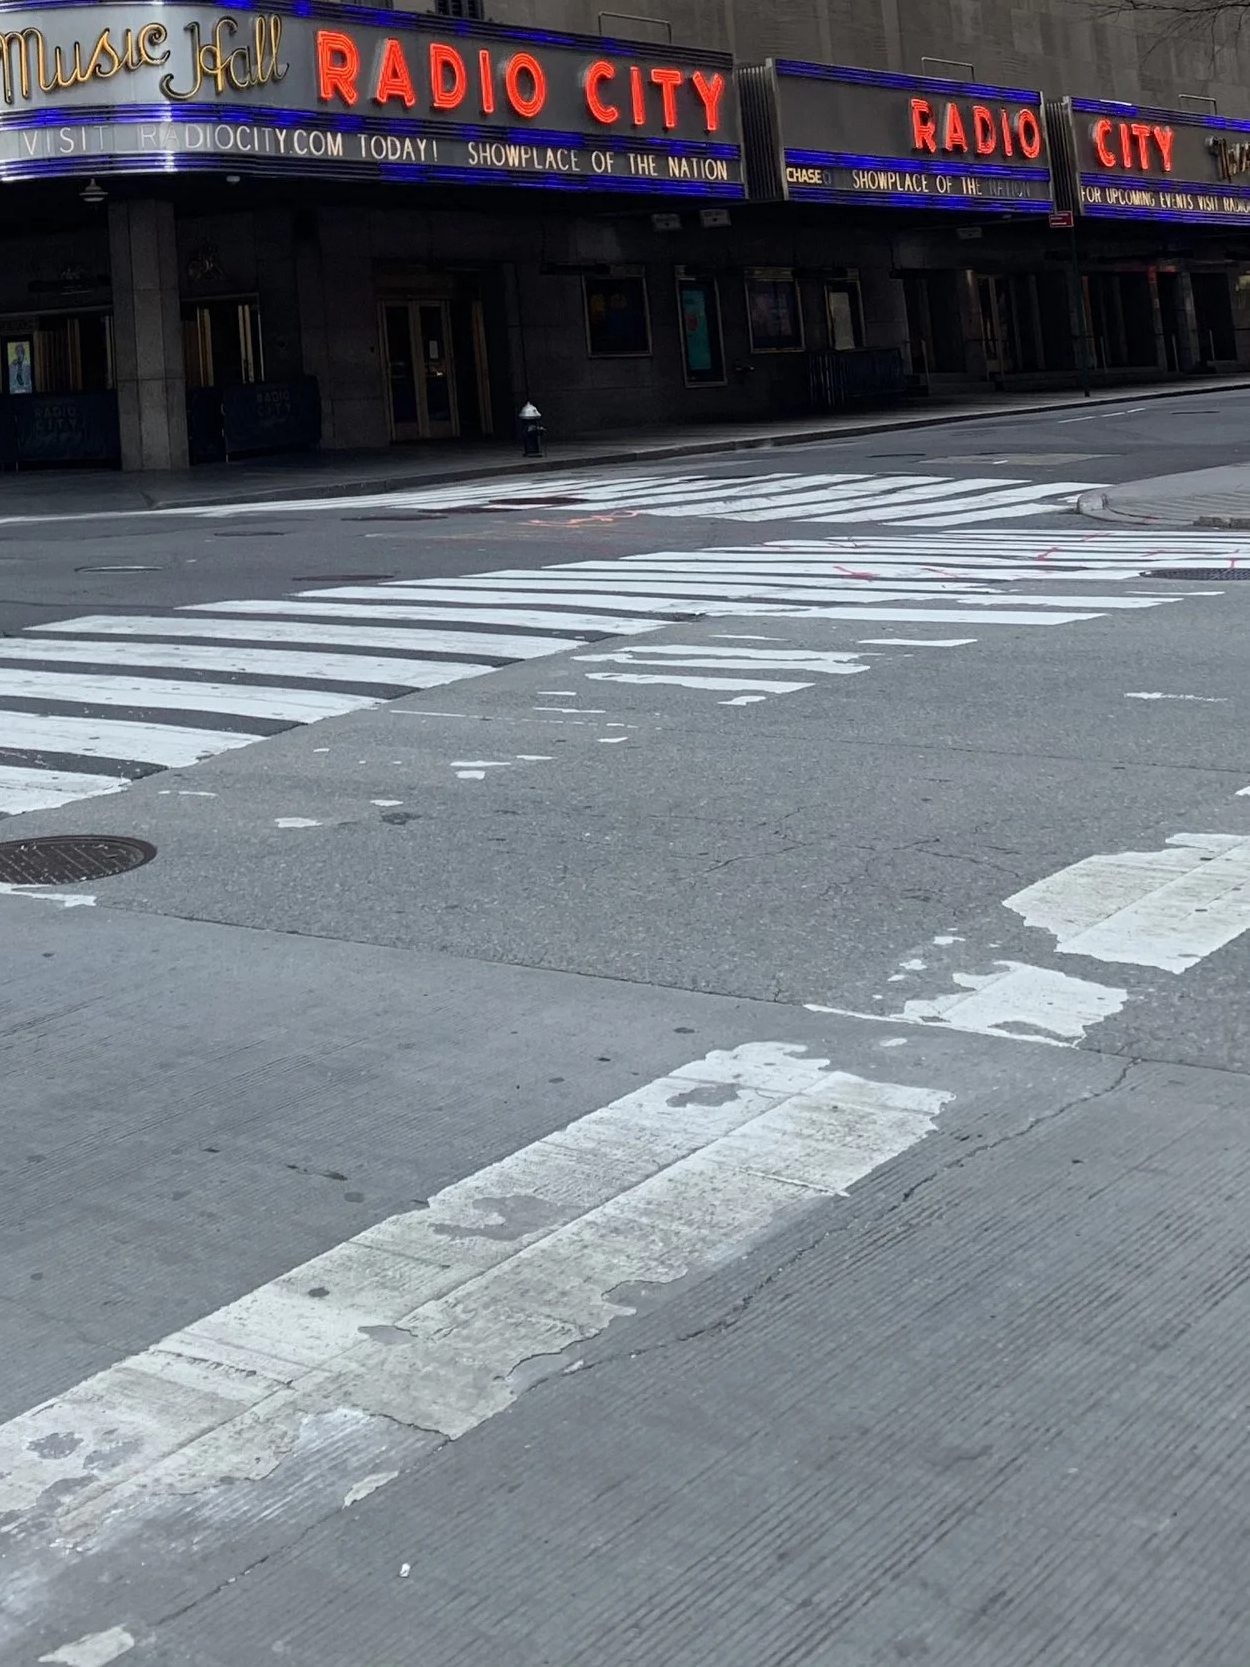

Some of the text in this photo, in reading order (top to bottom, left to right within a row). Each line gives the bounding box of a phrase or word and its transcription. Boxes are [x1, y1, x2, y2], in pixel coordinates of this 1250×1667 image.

[159, 12, 290, 102] Hall
[315, 28, 547, 119] RADIO
[584, 58, 726, 132] CITY
[22, 124, 106, 155] VISIT
[141, 123, 343, 158] RADIOCITY.COM
[358, 133, 440, 163] TODAY!
[467, 140, 581, 173] SHOWPLACE
[592, 150, 615, 175] OF
[628, 152, 658, 178] THE
[668, 156, 729, 182] NATION
[909, 97, 1042, 159] RADIO
[1090, 117, 1175, 173] CITY
[786, 166, 822, 185] CHASE
[852, 168, 929, 194] SHOWPLACE
[935, 174, 953, 194] OF
[960, 176, 982, 196] THE
[1081, 185, 1101, 203] FOR
[1106, 186, 1155, 207] UPCOMING
[1159, 191, 1194, 210] EVENTS
[1196, 195, 1218, 212] VISIT
